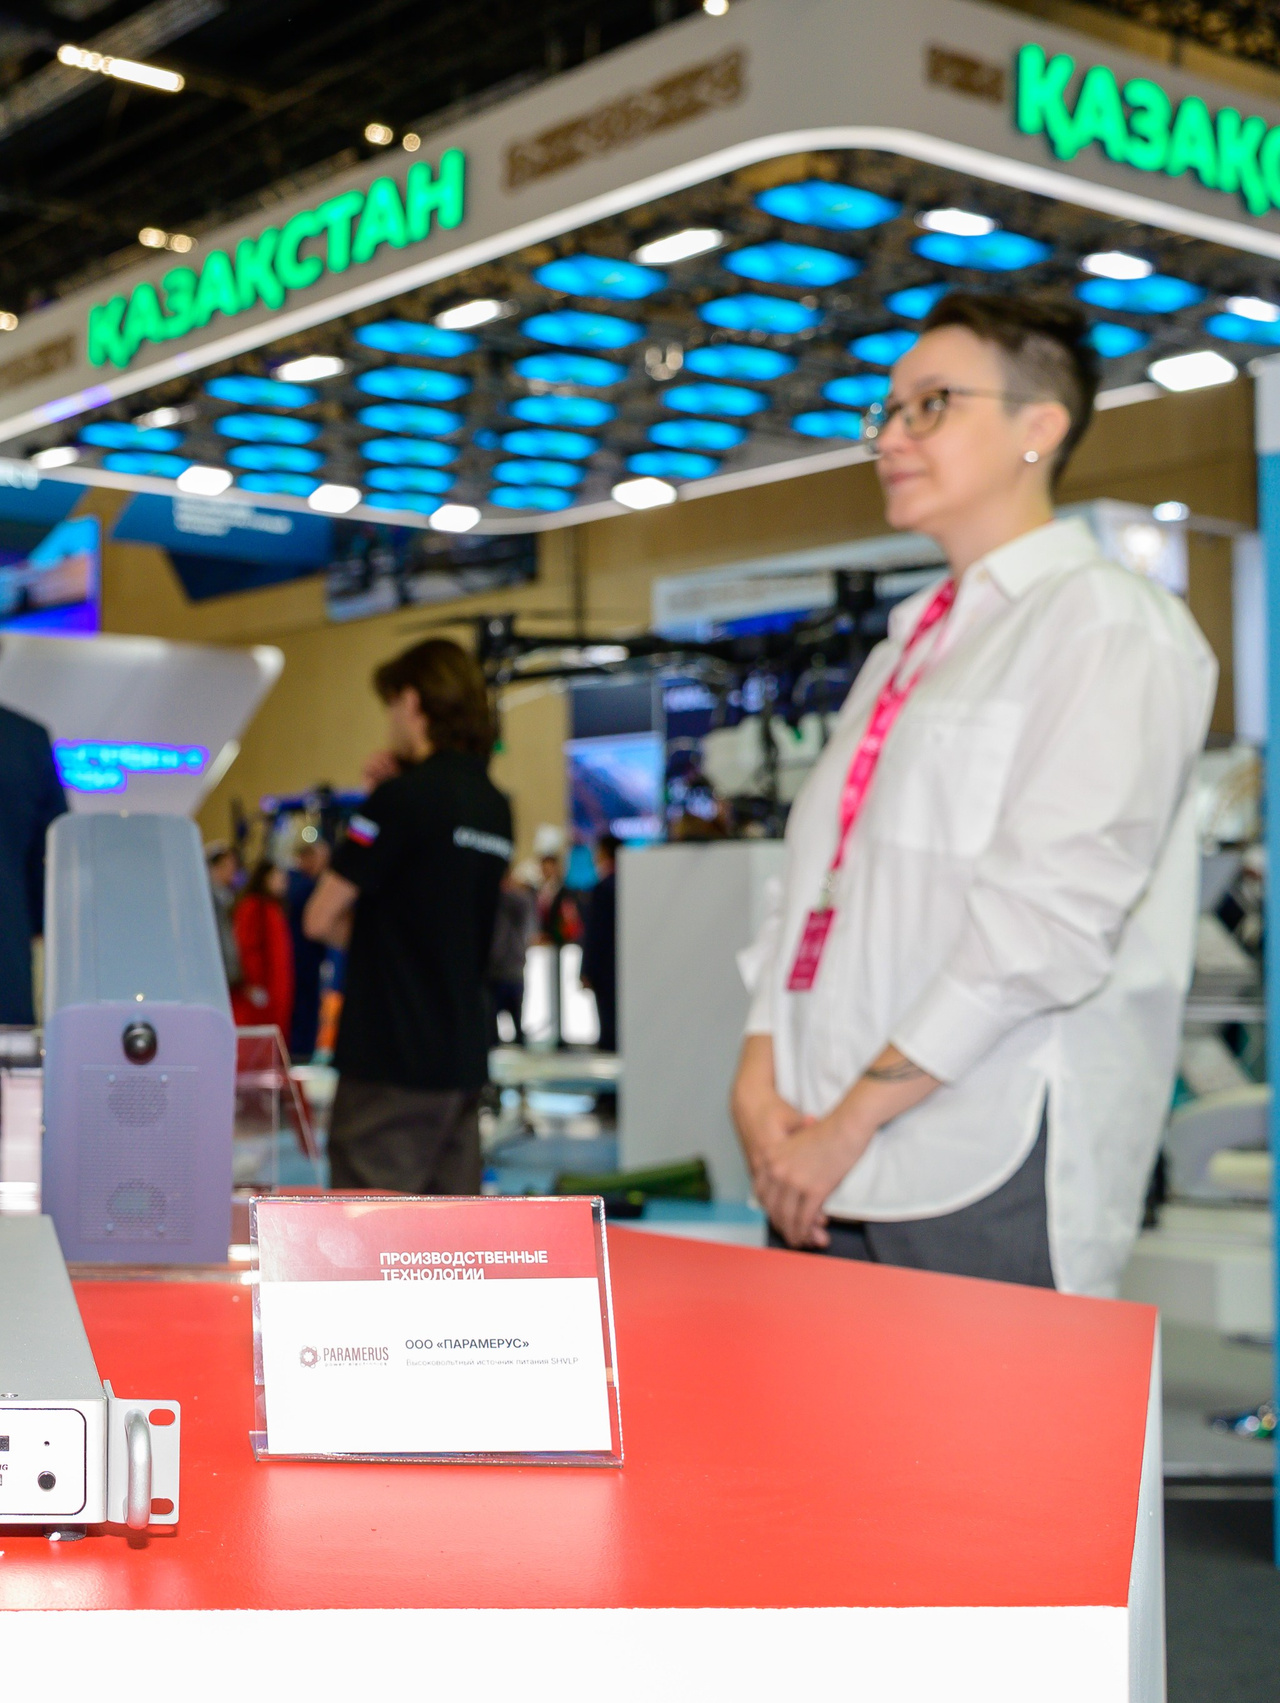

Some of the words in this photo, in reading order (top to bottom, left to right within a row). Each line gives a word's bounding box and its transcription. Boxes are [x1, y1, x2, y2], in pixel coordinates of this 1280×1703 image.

[87, 147, 466, 369] ҚАЗАҚСТАН
[379, 1250, 548, 1266] ПРОИЗВОДСТВЕННЫЕ
[381, 1268, 485, 1281] ТЕХНОЛОГИИ
[405, 1339, 433, 1349] ООО
[436, 1338, 530, 1349] «ПАРАМЕРУС»
[323, 1347, 389, 1361] PARAMERUS
